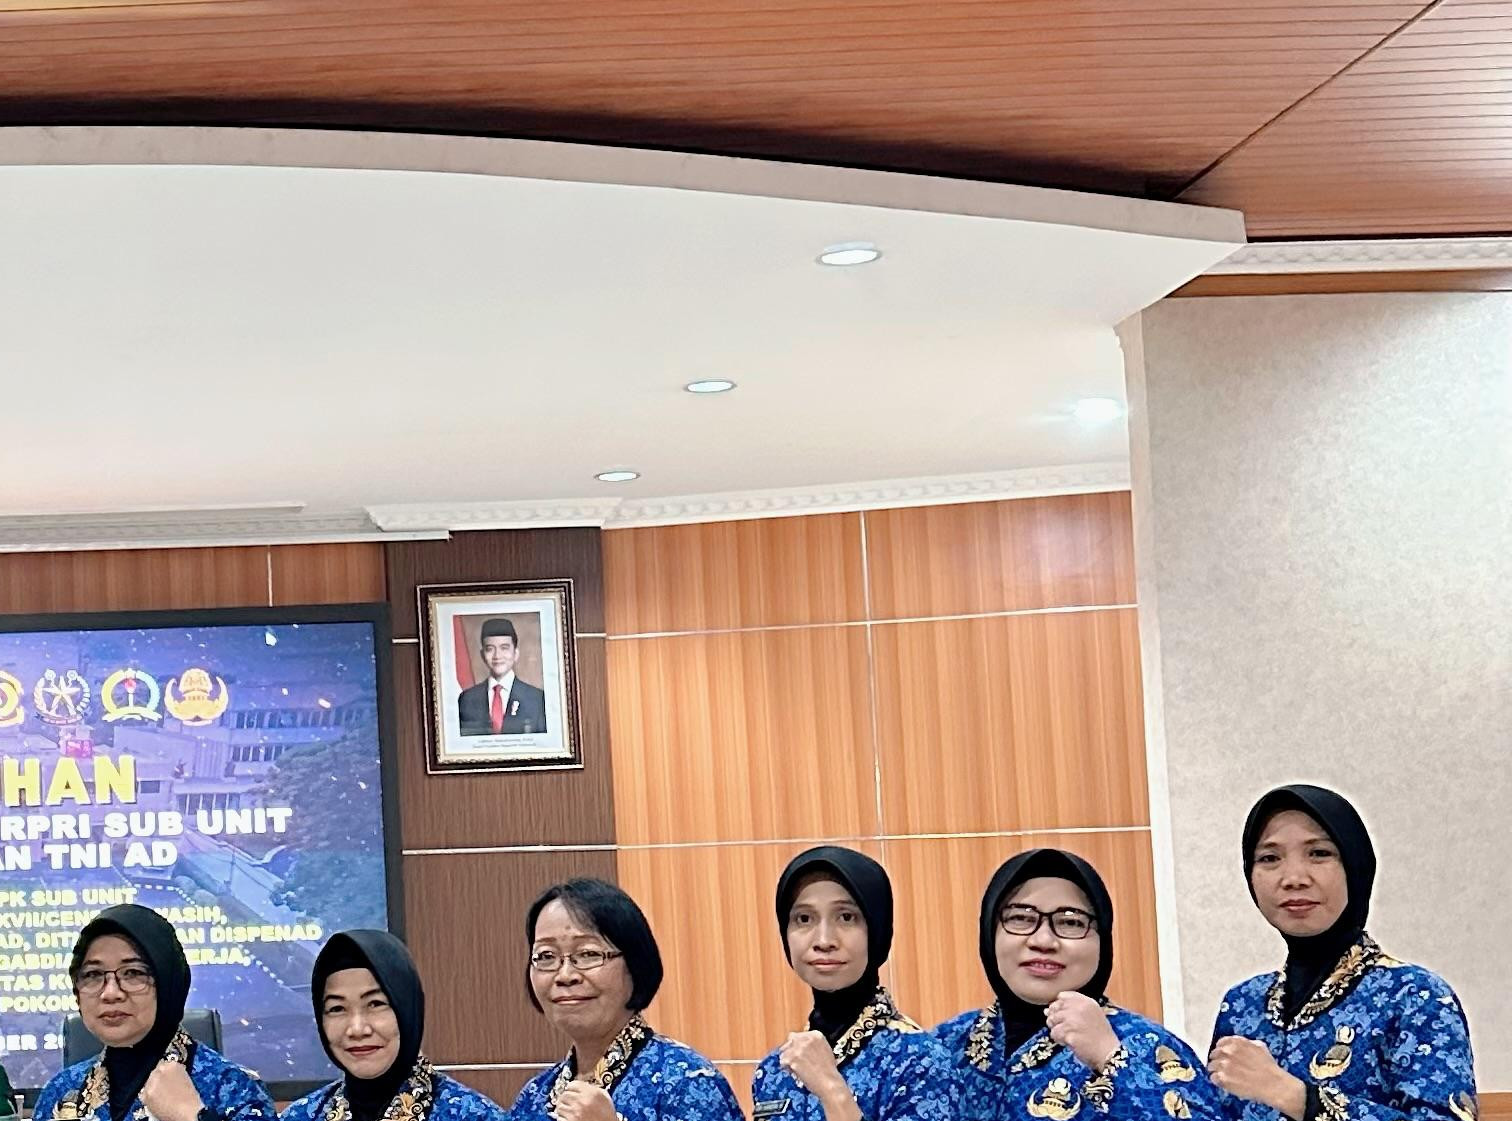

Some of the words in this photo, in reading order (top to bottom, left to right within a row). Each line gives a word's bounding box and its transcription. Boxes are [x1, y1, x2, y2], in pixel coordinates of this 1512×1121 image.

[104, 811, 184, 838] SUB
[196, 807, 294, 836] UNIT
[44, 842, 112, 871] TNI
[123, 840, 179, 868] AD
[31, 889, 78, 907] SUB
[81, 886, 138, 906] UNIT
[175, 926, 206, 945] AN
[210, 923, 323, 944] DISPENAD
[0, 994, 80, 1013] POKOK
